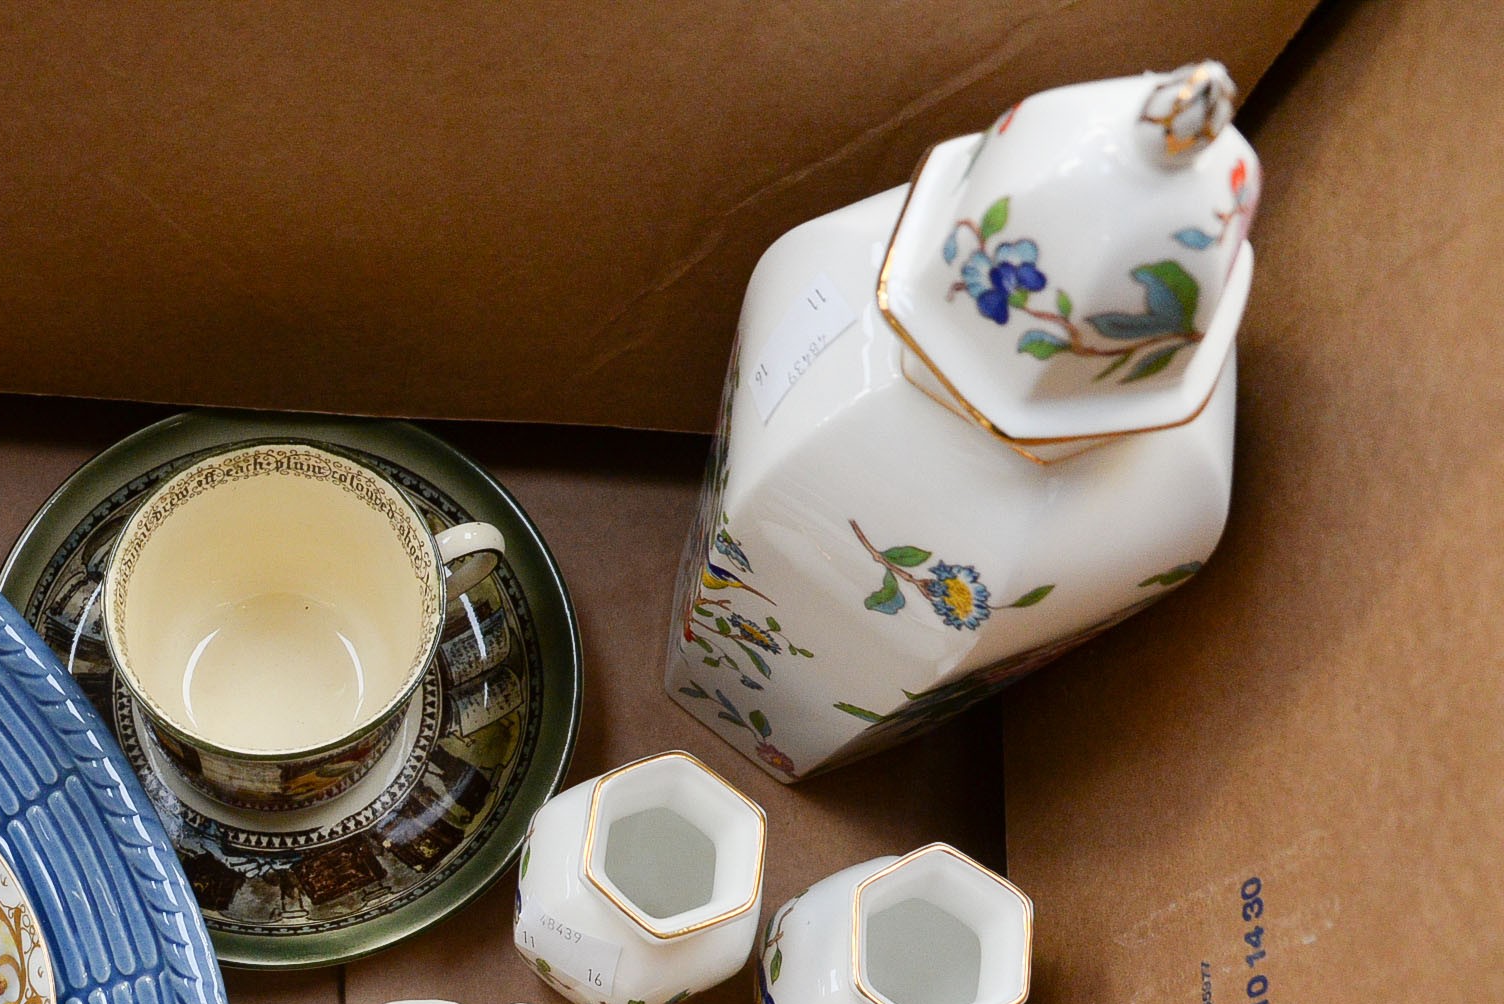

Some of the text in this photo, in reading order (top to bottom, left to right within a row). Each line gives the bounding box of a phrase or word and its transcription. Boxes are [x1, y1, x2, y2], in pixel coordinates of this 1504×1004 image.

[755, 363, 768, 386] 16
[1241, 876, 1264, 922] 30
[523, 930, 535, 948] 11
[540, 914, 582, 943] 48439
[1244, 925, 1266, 968] 14
[587, 968, 602, 986] 16
